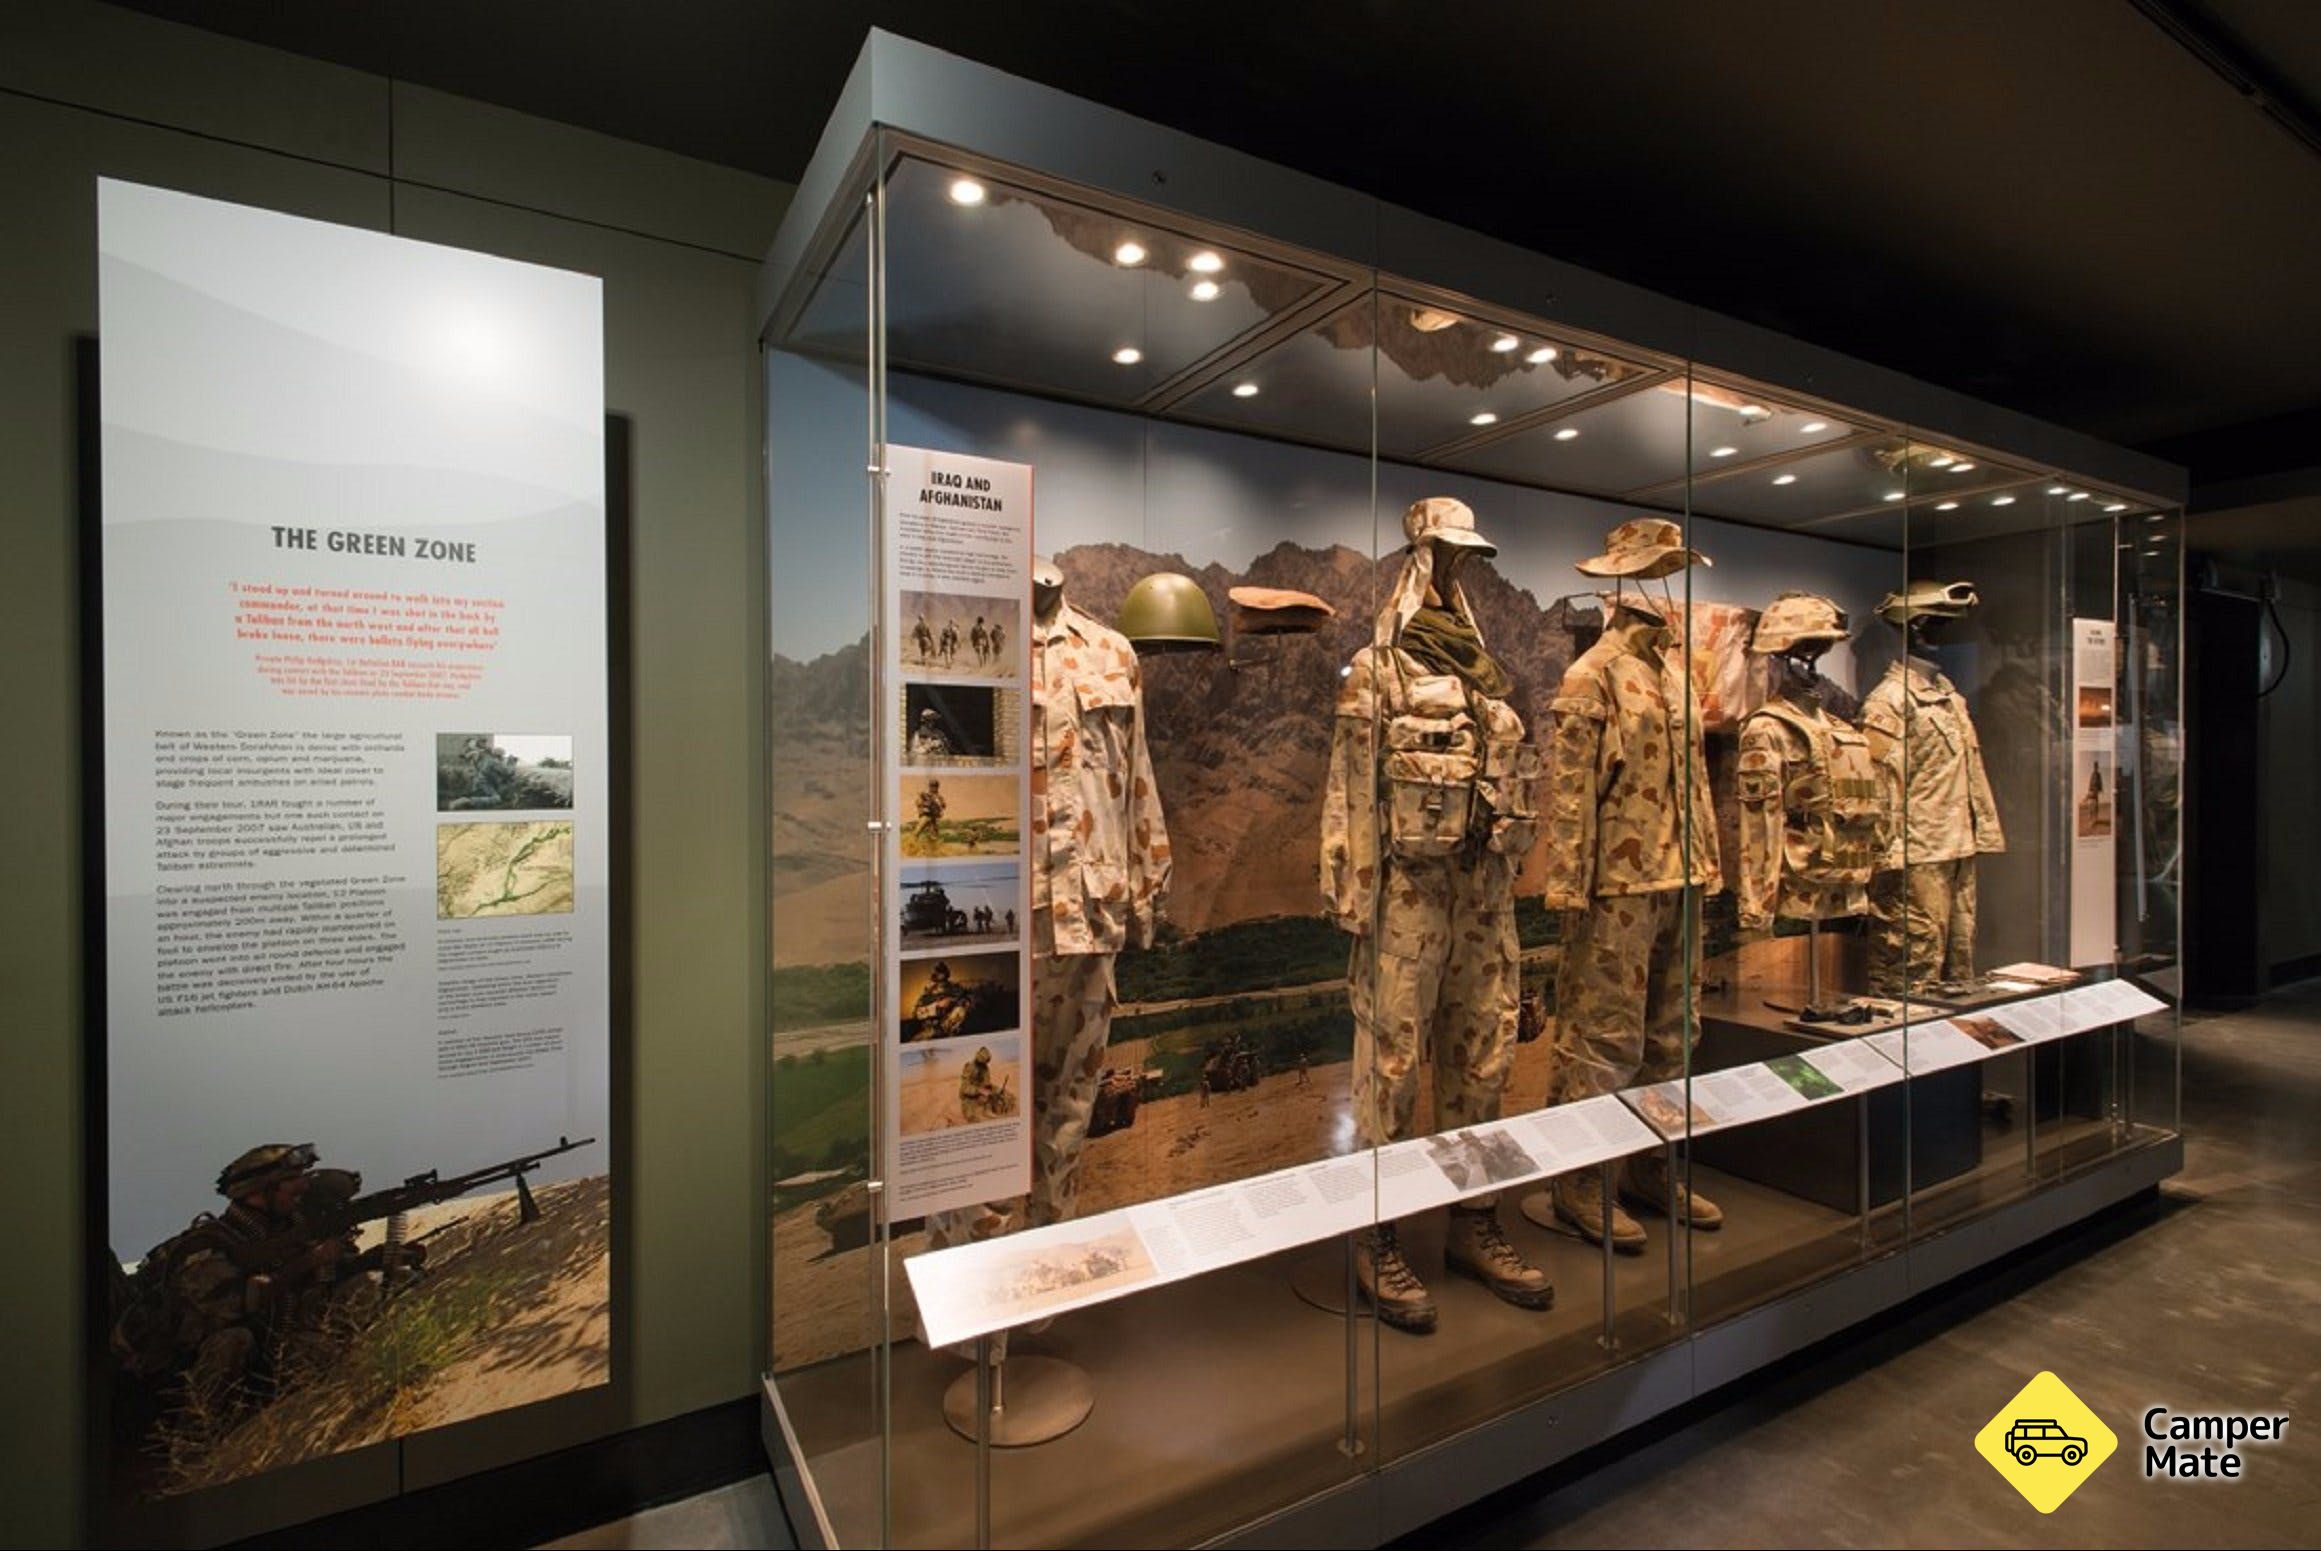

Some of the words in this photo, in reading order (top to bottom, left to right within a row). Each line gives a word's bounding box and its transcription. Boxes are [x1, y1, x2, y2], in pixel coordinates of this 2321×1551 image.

[931, 471, 962, 489] IRAQ
[965, 476, 991, 492] AND
[919, 488, 1003, 512] AFGHANISTAN
[271, 526, 317, 550] THE
[327, 531, 405, 557] GREEN
[414, 538, 476, 563] ZONE
